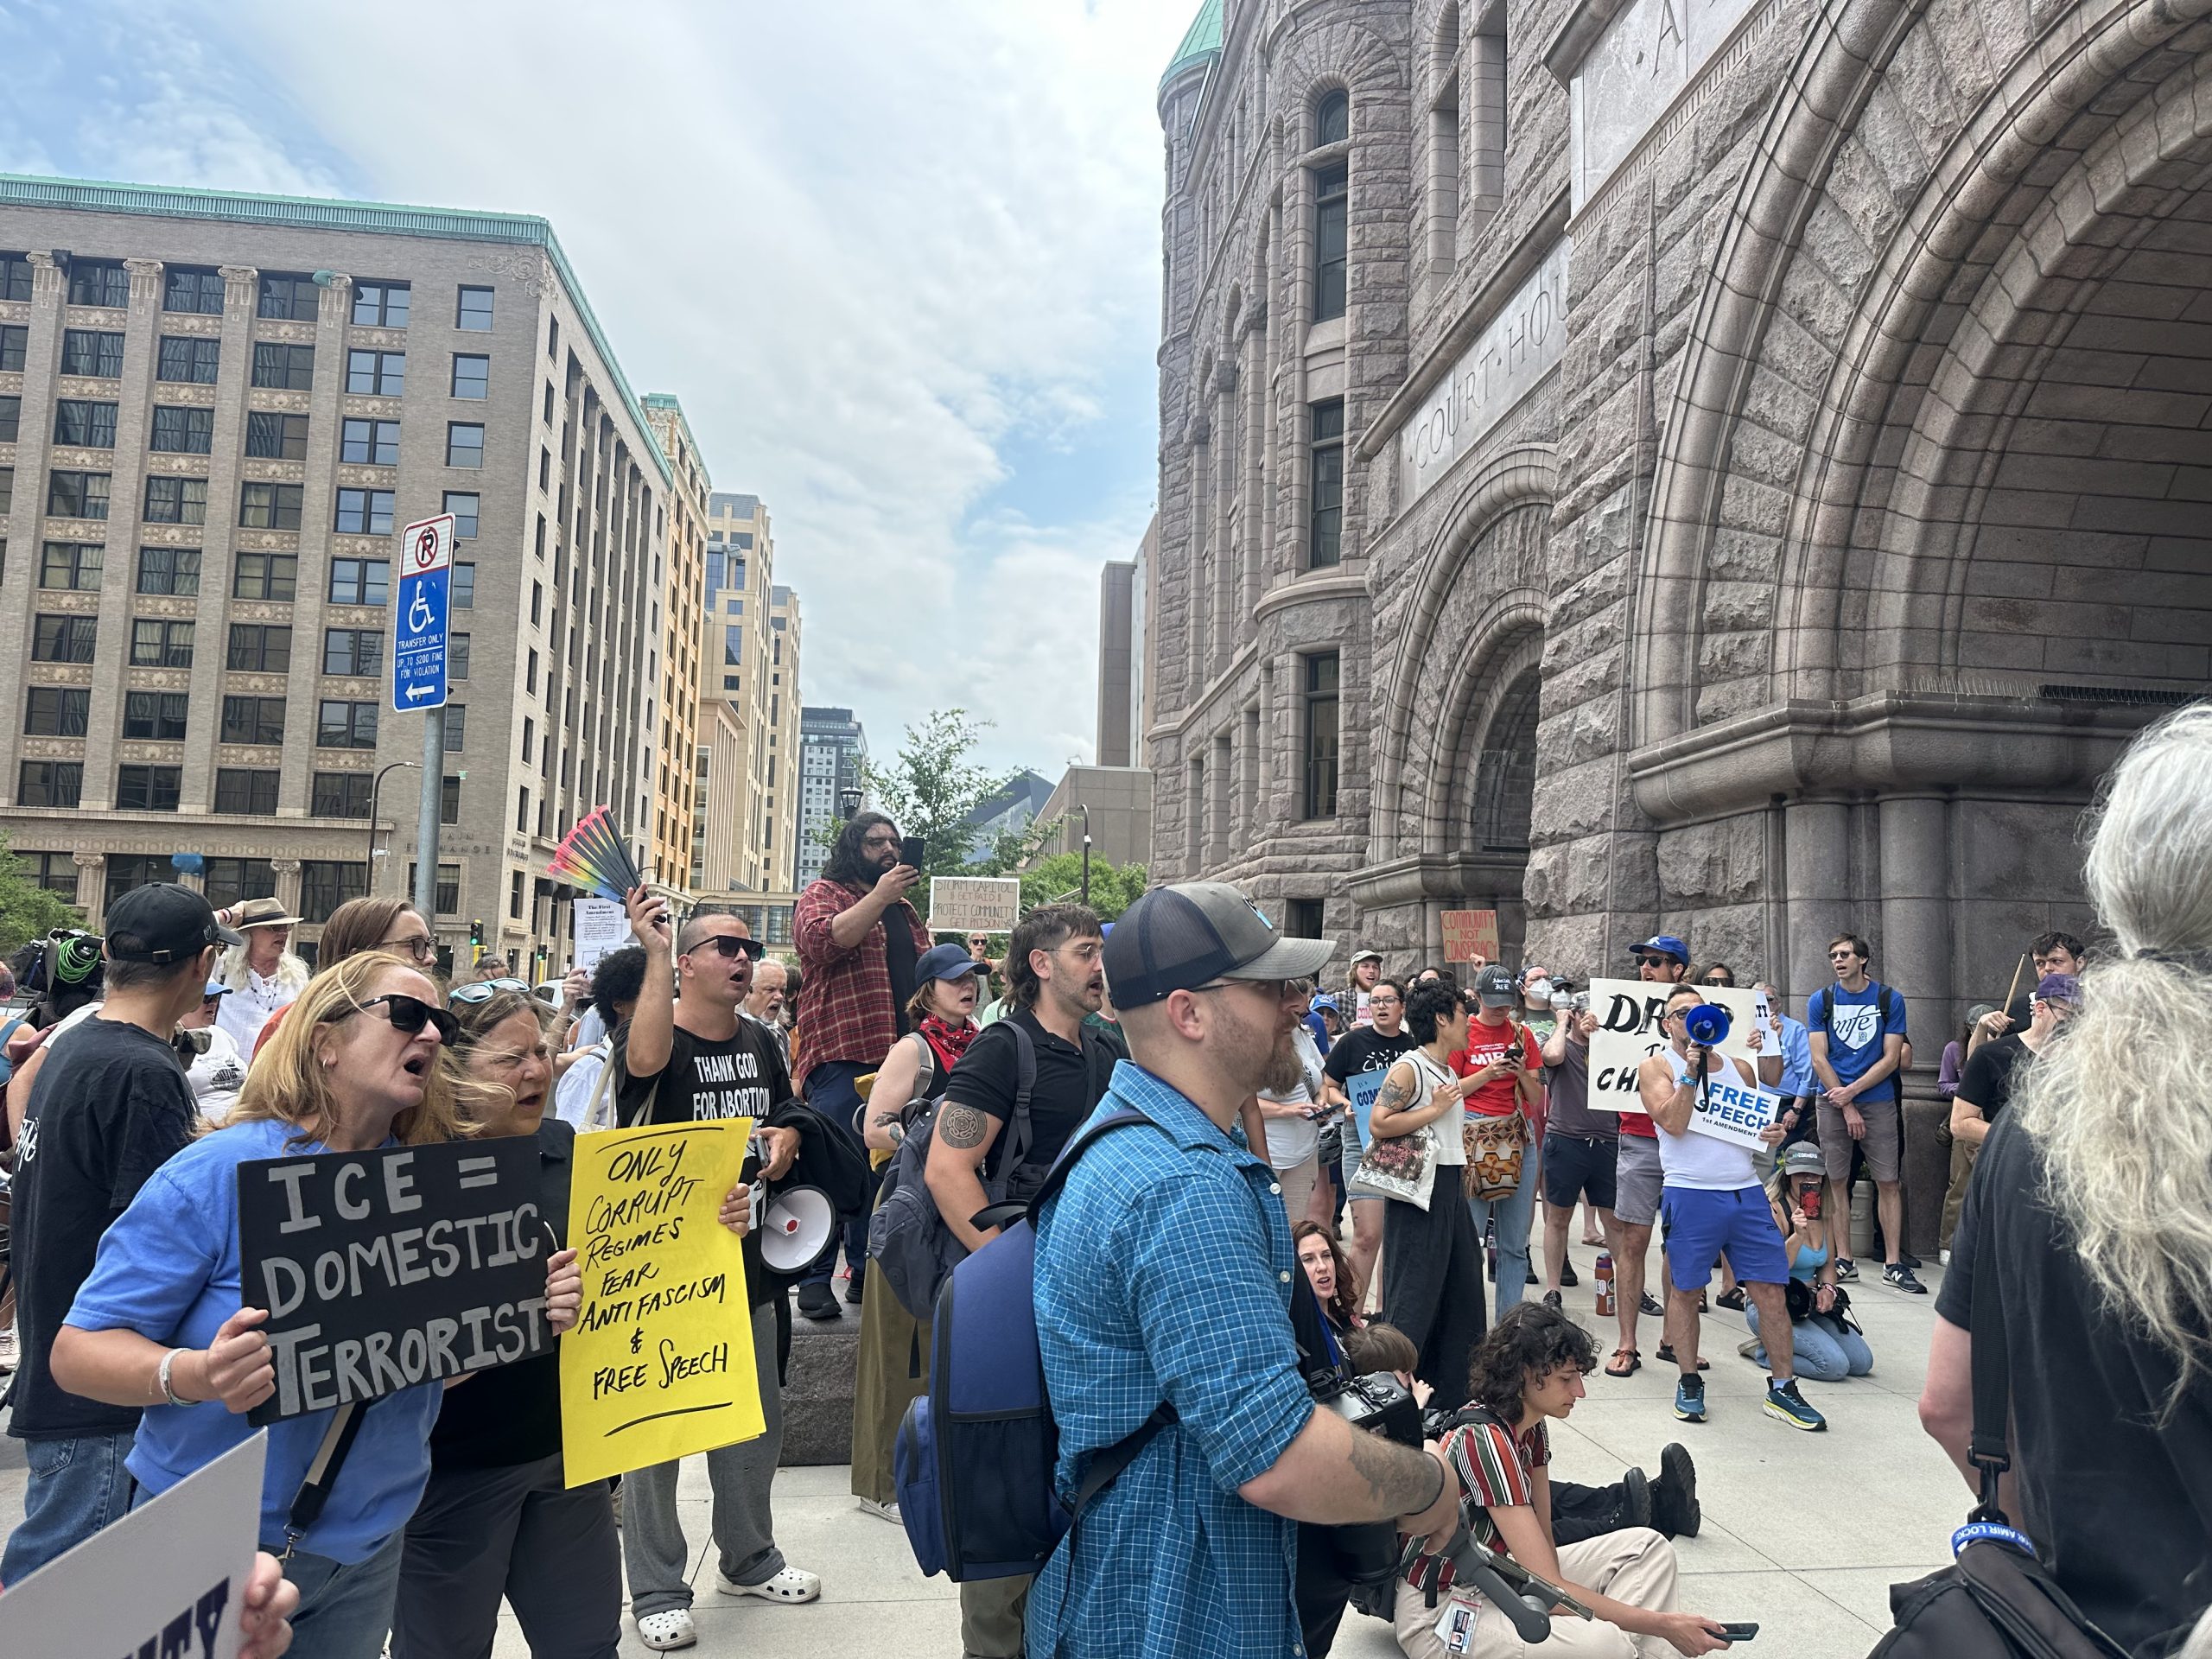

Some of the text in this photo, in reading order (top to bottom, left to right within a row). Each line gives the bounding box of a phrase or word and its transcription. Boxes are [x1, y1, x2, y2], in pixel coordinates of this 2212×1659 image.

[1416, 273, 1568, 468] COURT HOU
[398, 632, 443, 650] TRANSFER ONLY
[397, 652, 442, 668] UP TO $200 FINE
[401, 664, 439, 679] FOR VIOLATION
[934, 880, 1014, 893] STORM CAPITOL
[957, 892, 973, 900] GET
[974, 893, 995, 901] PAID
[934, 903, 1014, 918] PROTECT COMMUNITY
[950, 918, 965, 927] GET
[969, 918, 1000, 928] PRISON
[1443, 912, 1494, 930] COMMUNITY
[1460, 930, 1479, 939] NOT
[1445, 940, 1497, 960] CONSPIRACY
[694, 1052, 758, 1083] THANK GOD
[693, 1086, 770, 1121] FOR ABORTION
[1709, 1082, 1770, 1115] FREE
[1713, 1121, 1758, 1137] AMENDMENT
[608, 1140, 688, 1186] ONLY
[268, 1151, 422, 1234] ICE
[586, 1178, 705, 1234] CORRUPT
[585, 1217, 683, 1272] REGIMES
[261, 1203, 538, 1319] DOMESTIC
[601, 1262, 659, 1297] FEAR
[267, 1297, 548, 1416] TERRORIST
[594, 1338, 728, 1401] FREE SPEECH
[1989, 1525, 2016, 1538] AMIR
